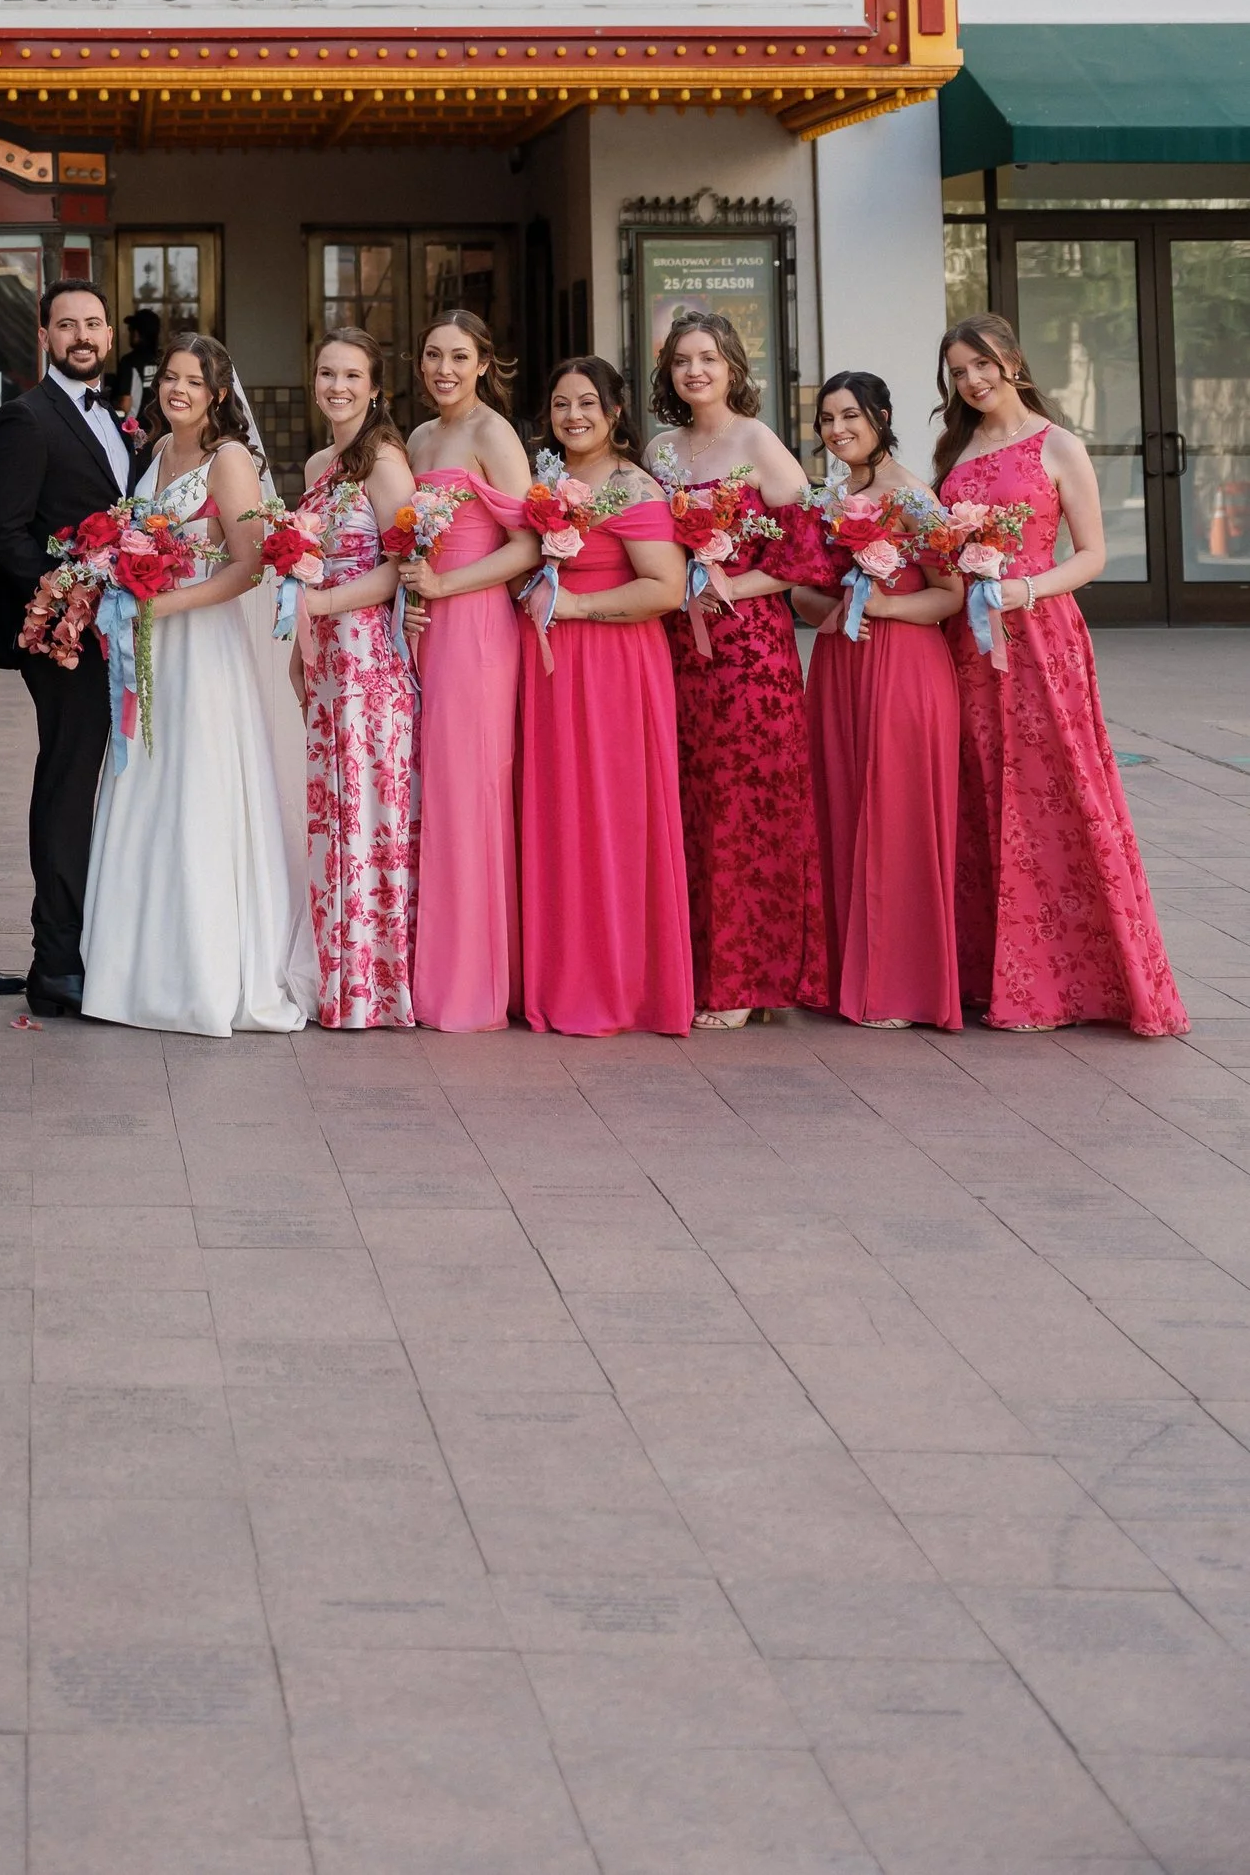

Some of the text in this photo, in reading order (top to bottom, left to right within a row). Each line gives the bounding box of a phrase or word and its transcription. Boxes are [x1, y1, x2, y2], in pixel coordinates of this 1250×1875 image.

[653, 257, 711, 266] BROADWAY
[721, 257, 734, 266] EL
[736, 256, 764, 265] PASO
[664, 277, 754, 290] 25/26 SEASON
